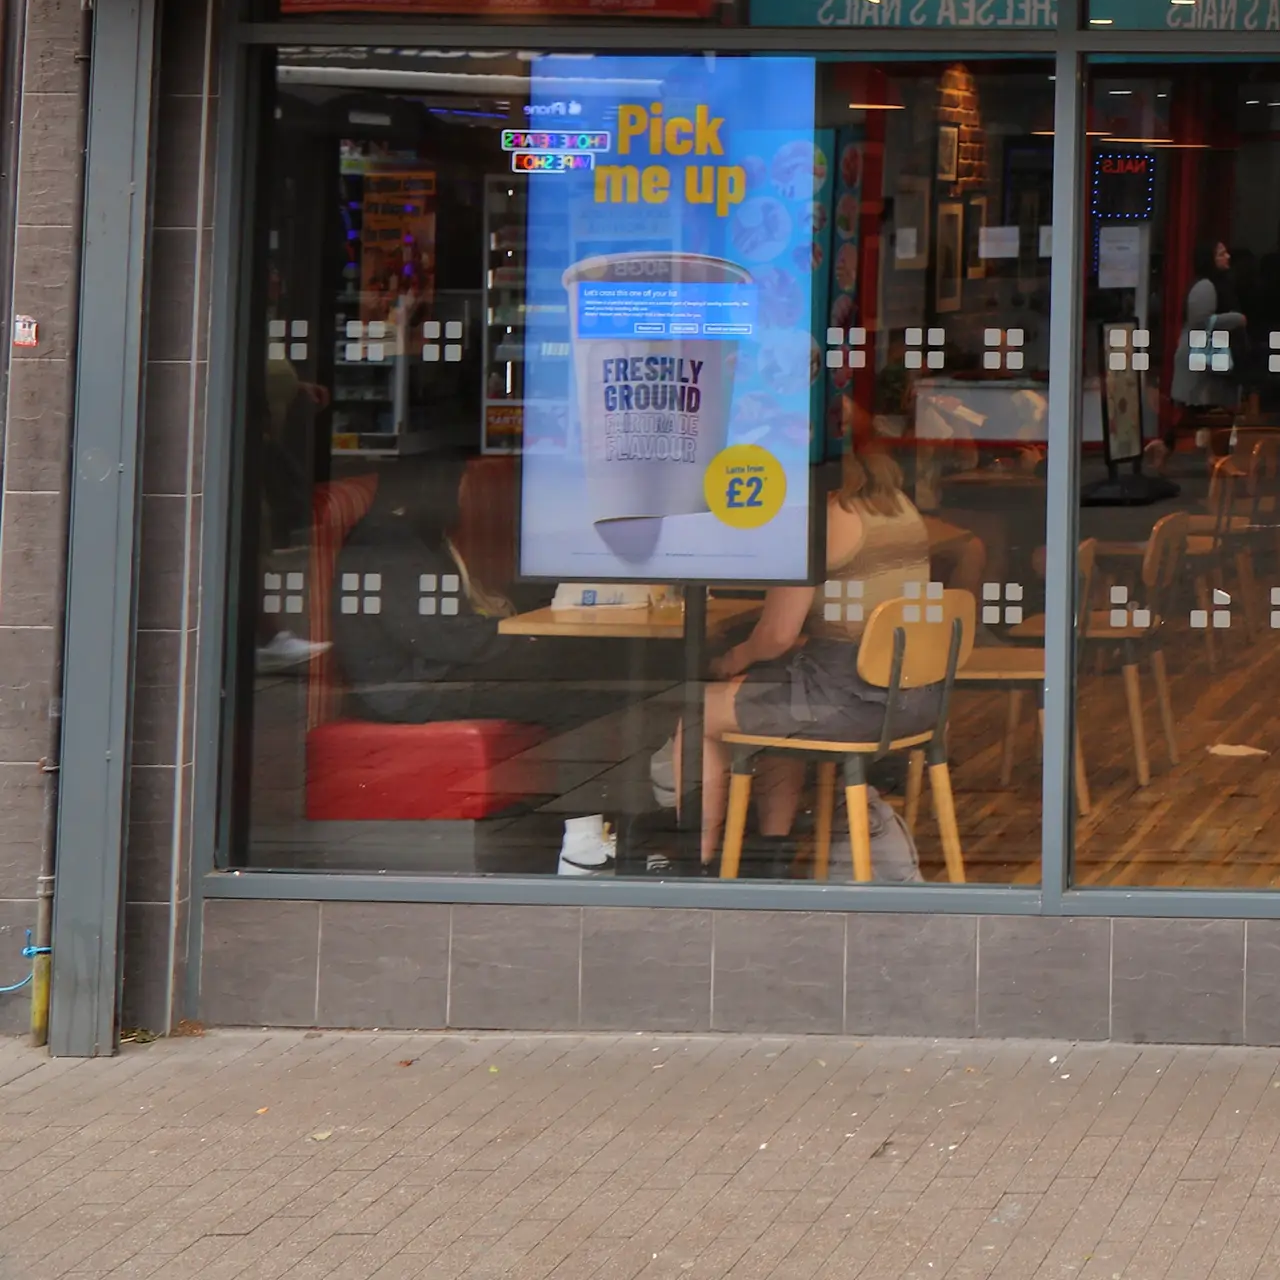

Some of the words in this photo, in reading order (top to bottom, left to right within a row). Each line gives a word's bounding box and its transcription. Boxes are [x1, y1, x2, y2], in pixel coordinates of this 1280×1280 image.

[617, 102, 725, 156] Pick
[594, 165, 671, 204] me
[684, 165, 746, 217] up
[603, 356, 704, 384] FRESHLY
[604, 383, 701, 413] GROUND
[604, 412, 699, 436] FAIRTRADE
[605, 435, 696, 463] FLAVOUR
